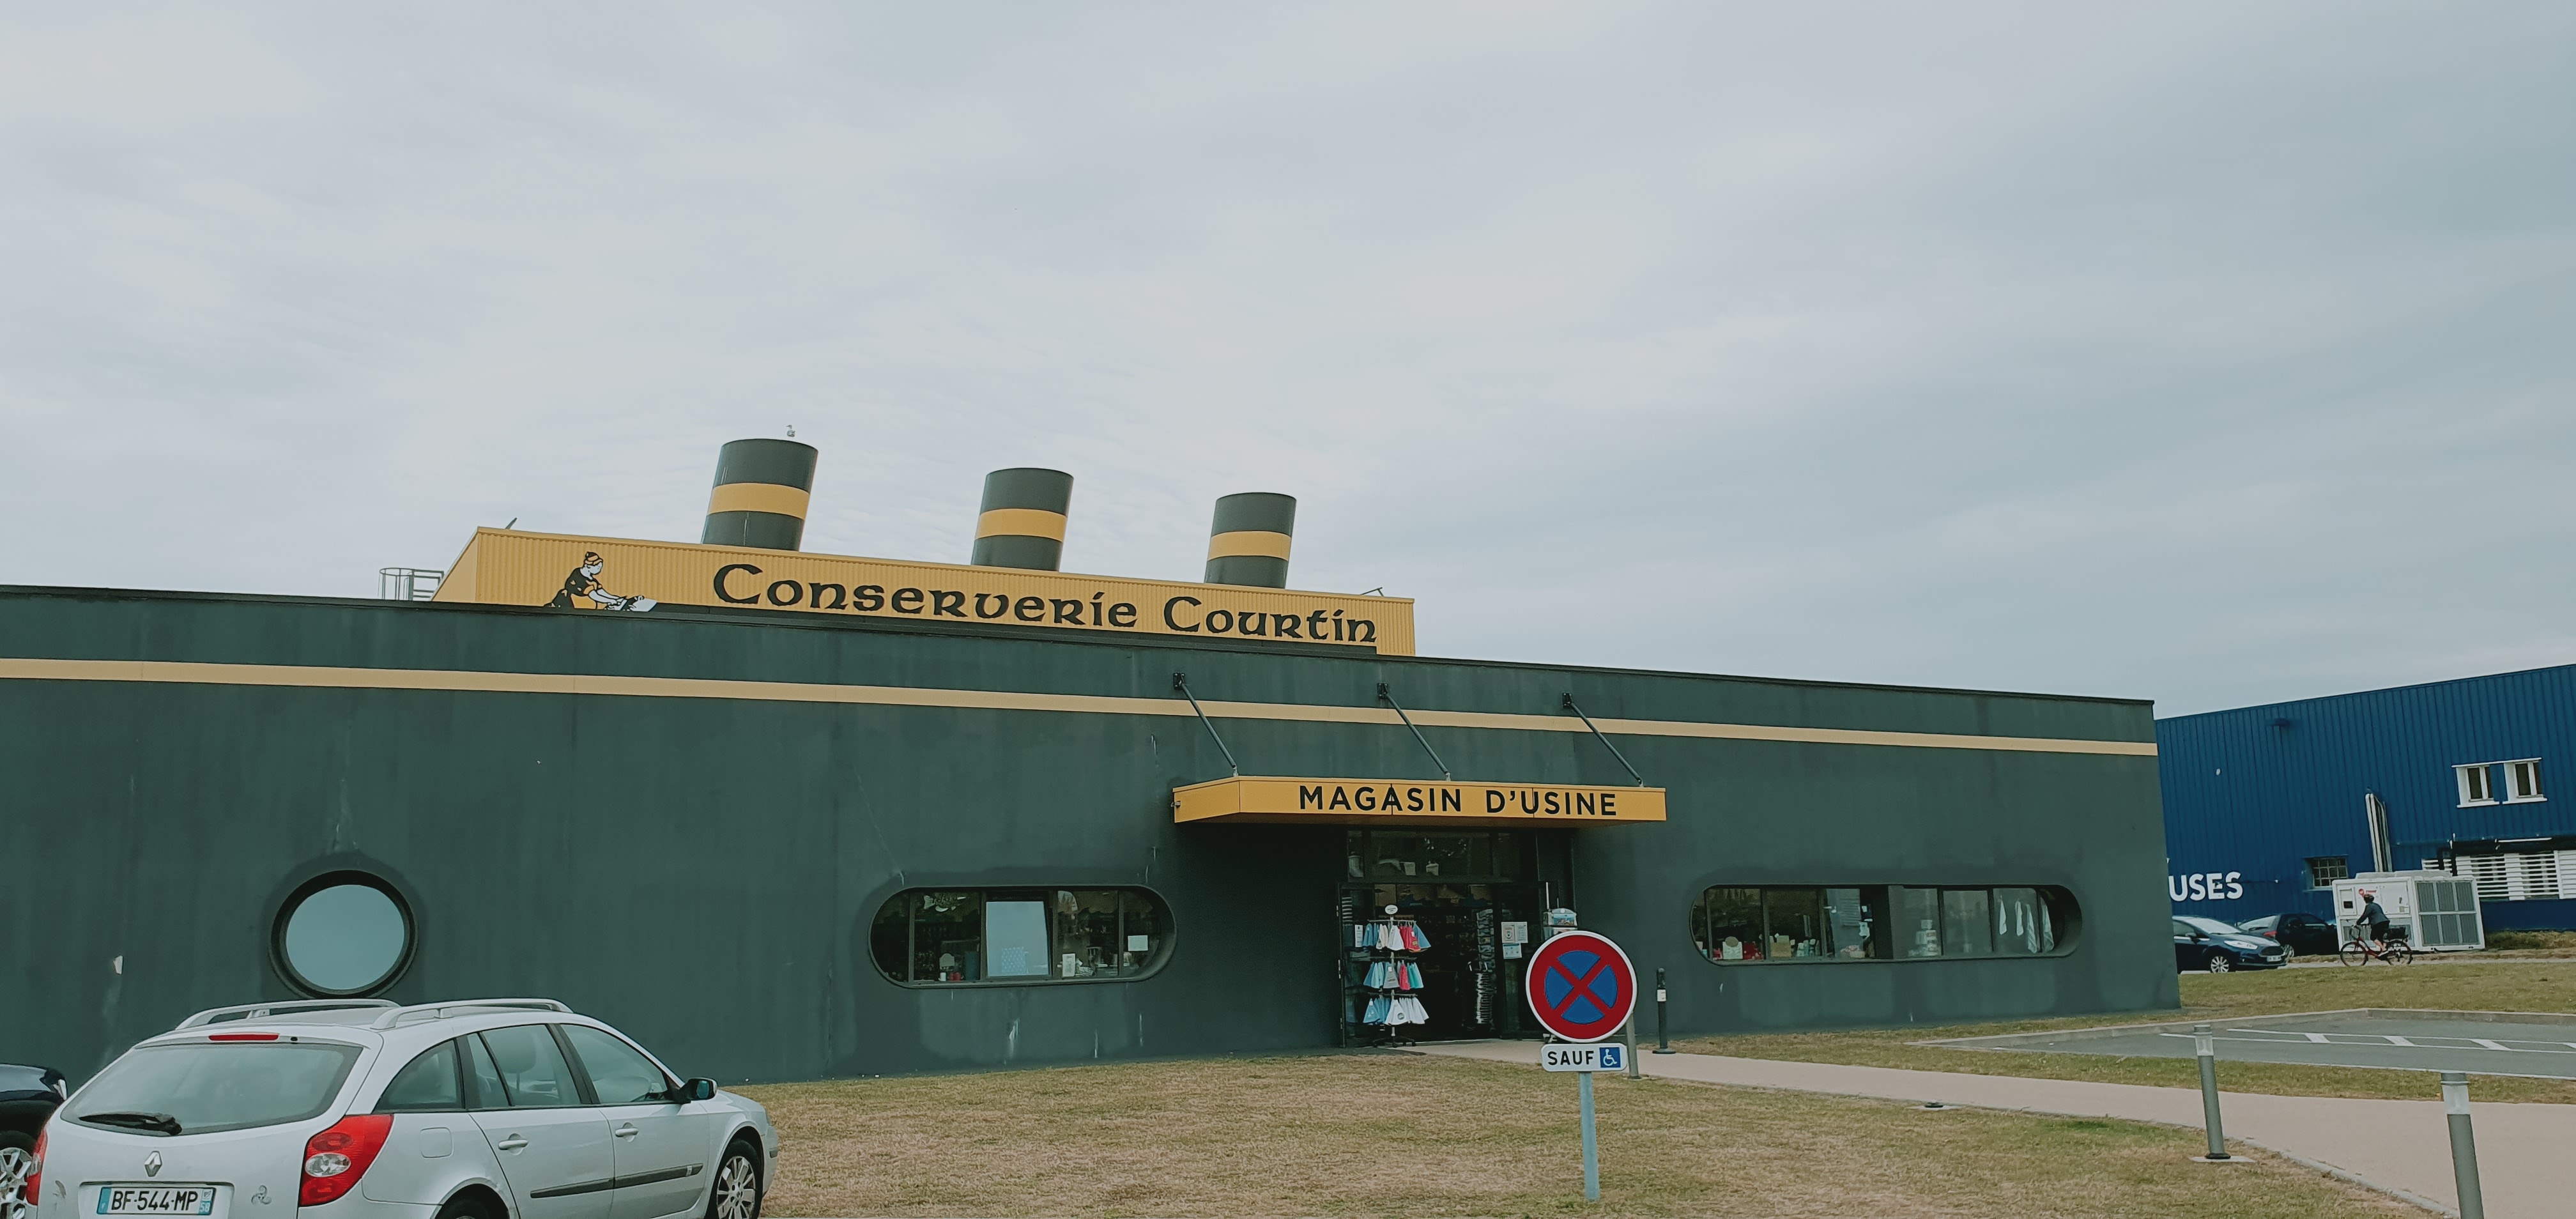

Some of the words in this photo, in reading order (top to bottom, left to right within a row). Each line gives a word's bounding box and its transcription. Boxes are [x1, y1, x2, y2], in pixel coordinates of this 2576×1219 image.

[713, 564, 1138, 627] Conserverie
[1163, 596, 1377, 643] Courtin
[1300, 785, 1461, 812] MAGASIN
[1486, 790, 1616, 816] D'USINE
[1547, 1050, 1595, 1066] SAUF
[111, 1191, 198, 1211] BF-544-MP
